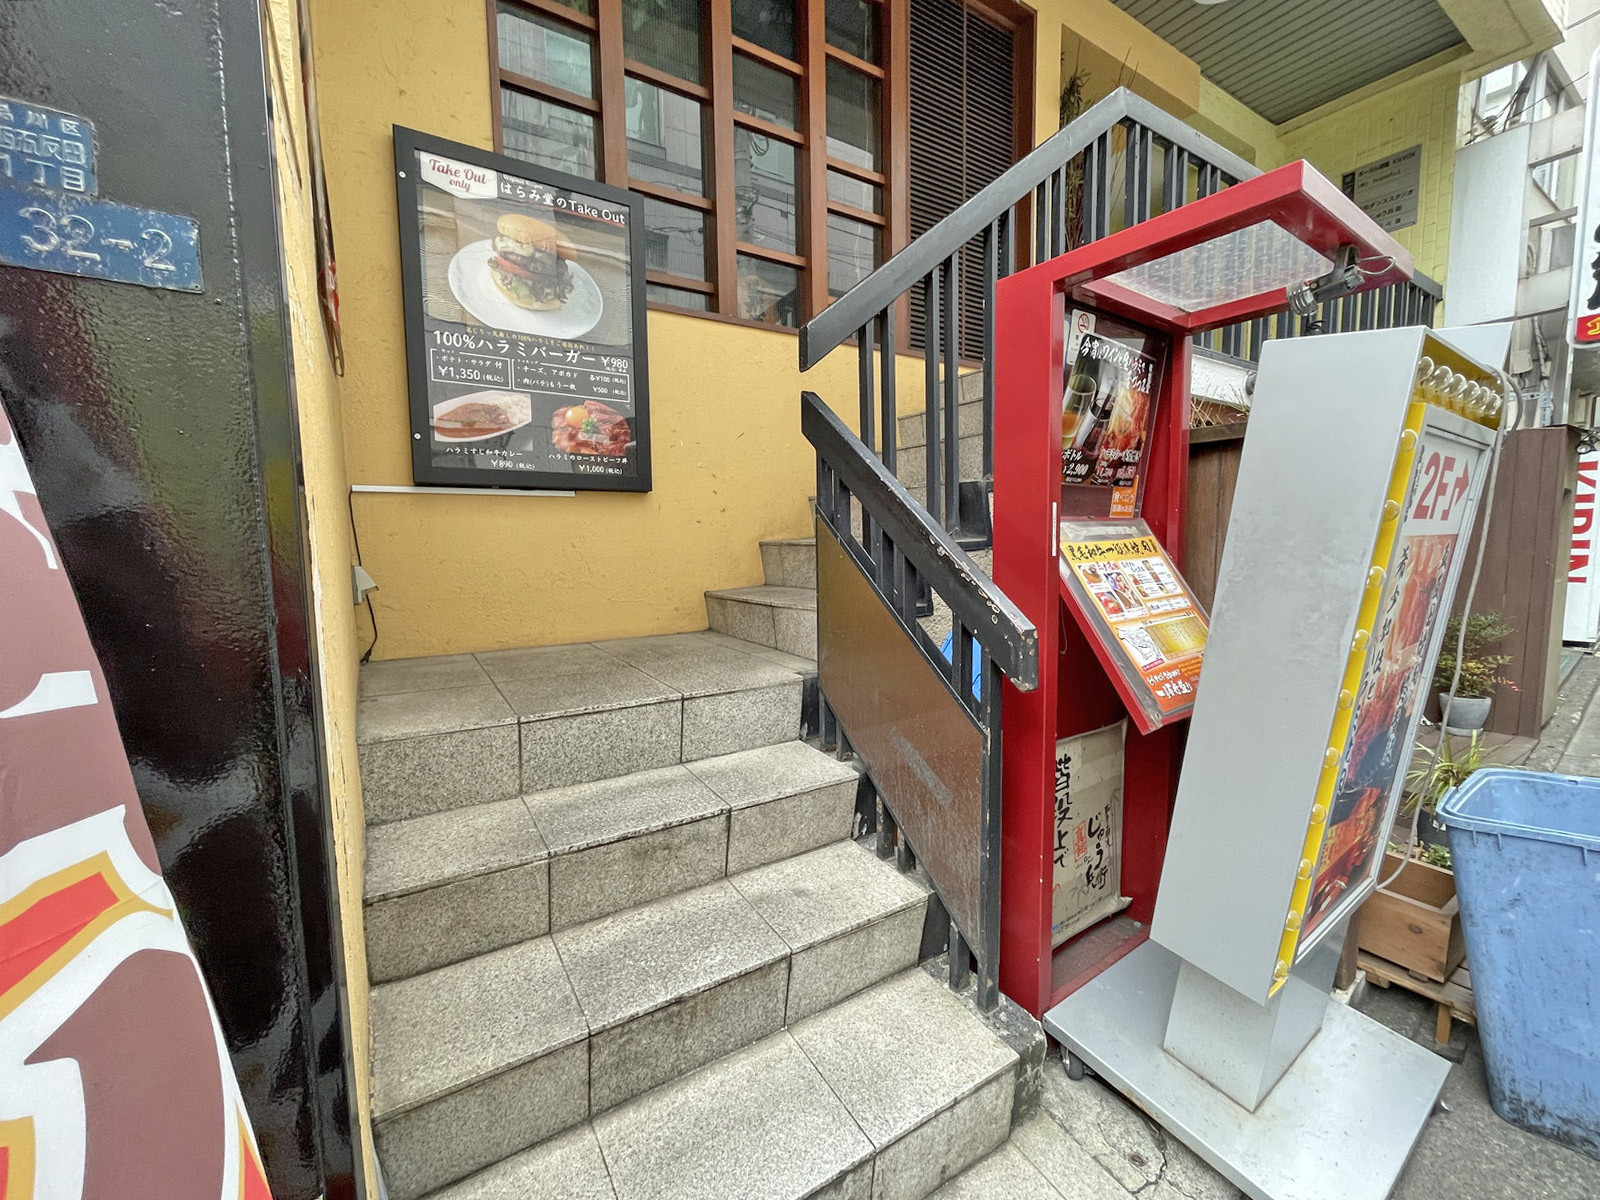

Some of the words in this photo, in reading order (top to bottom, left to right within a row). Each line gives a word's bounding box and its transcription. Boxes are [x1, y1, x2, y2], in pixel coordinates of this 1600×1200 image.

[429, 159, 461, 178] Take
[464, 168, 488, 184] Out
[449, 179, 471, 192] only
[601, 209, 626, 225] Out
[18, 207, 177, 272] 32-2
[433, 330, 596, 363] 100%ハラミバーガー
[601, 355, 629, 369] ¥980
[438, 365, 480, 381] ¥1,350
[592, 386, 609, 394] ¥500
[491, 459, 514, 469] ¥890
[1412, 451, 1456, 520] 2F
